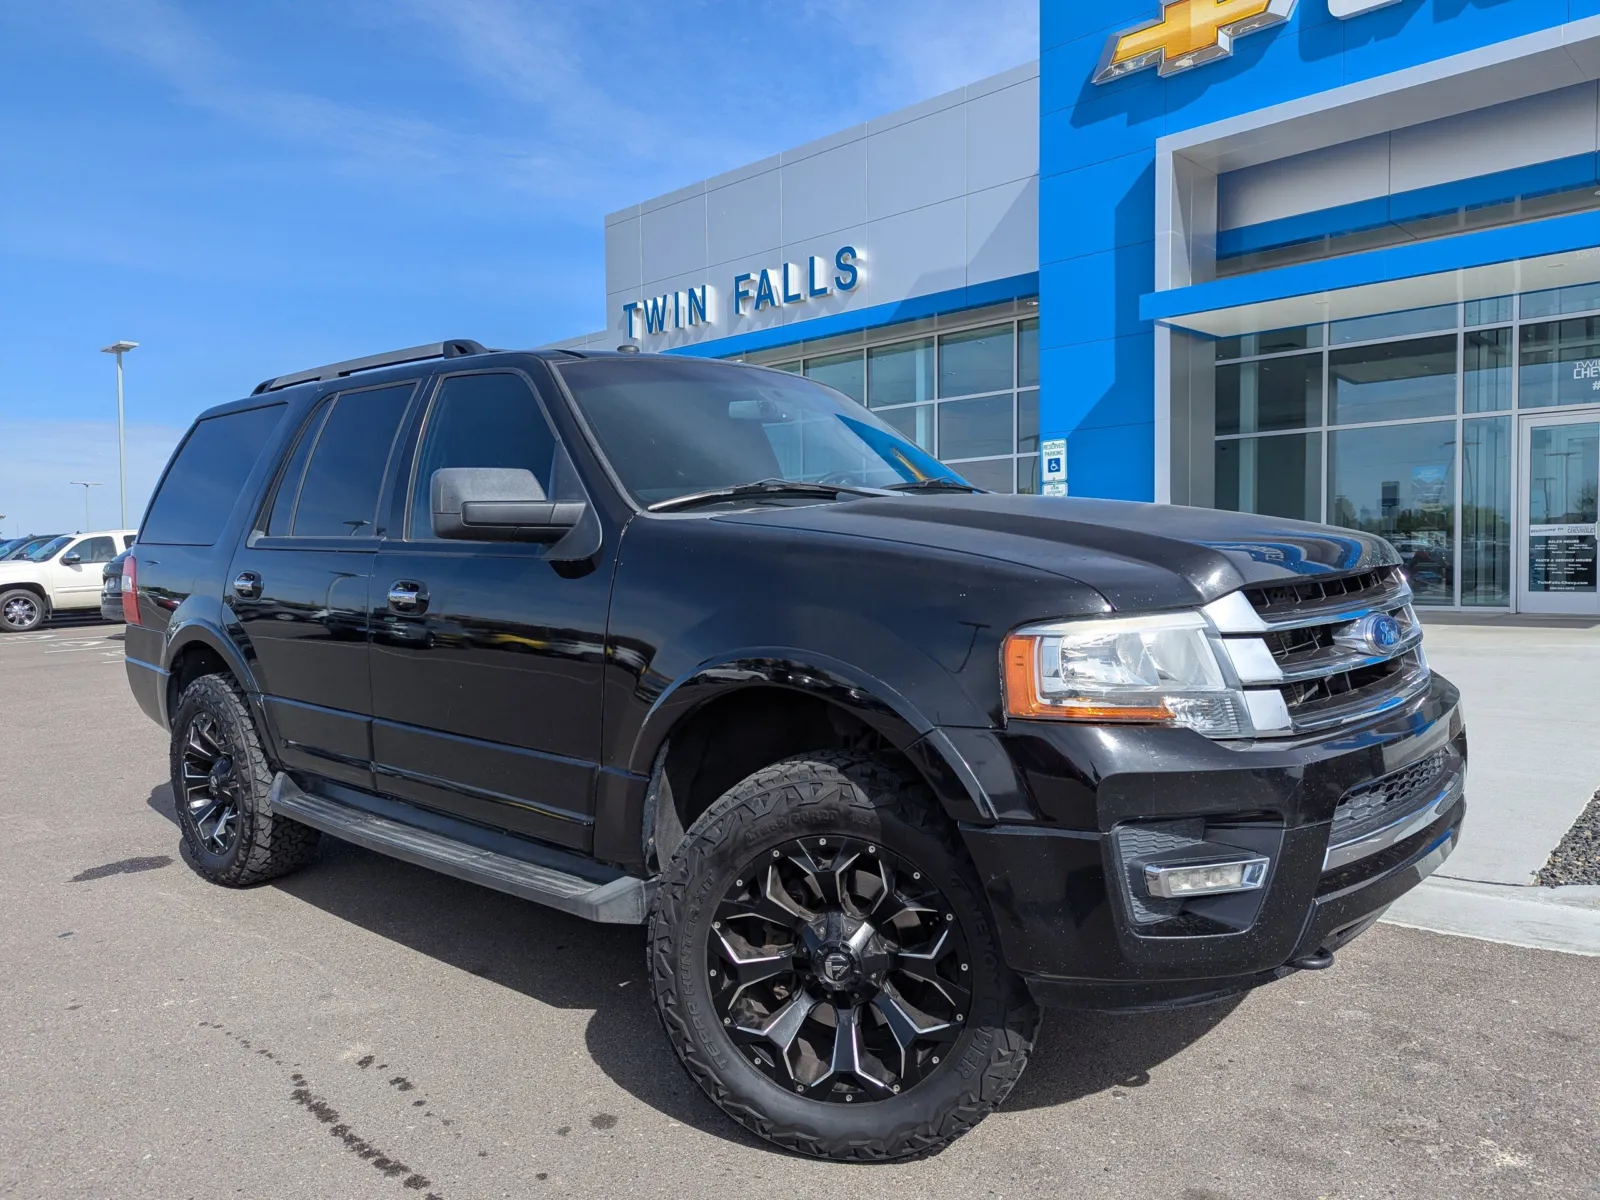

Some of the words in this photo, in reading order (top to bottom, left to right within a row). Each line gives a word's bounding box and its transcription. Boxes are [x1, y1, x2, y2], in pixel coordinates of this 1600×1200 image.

[622, 285, 711, 339] TWIN
[734, 246, 860, 315] FALLS
[680, 904, 700, 997] HUNTER
[686, 1001, 729, 1071] TERRA
